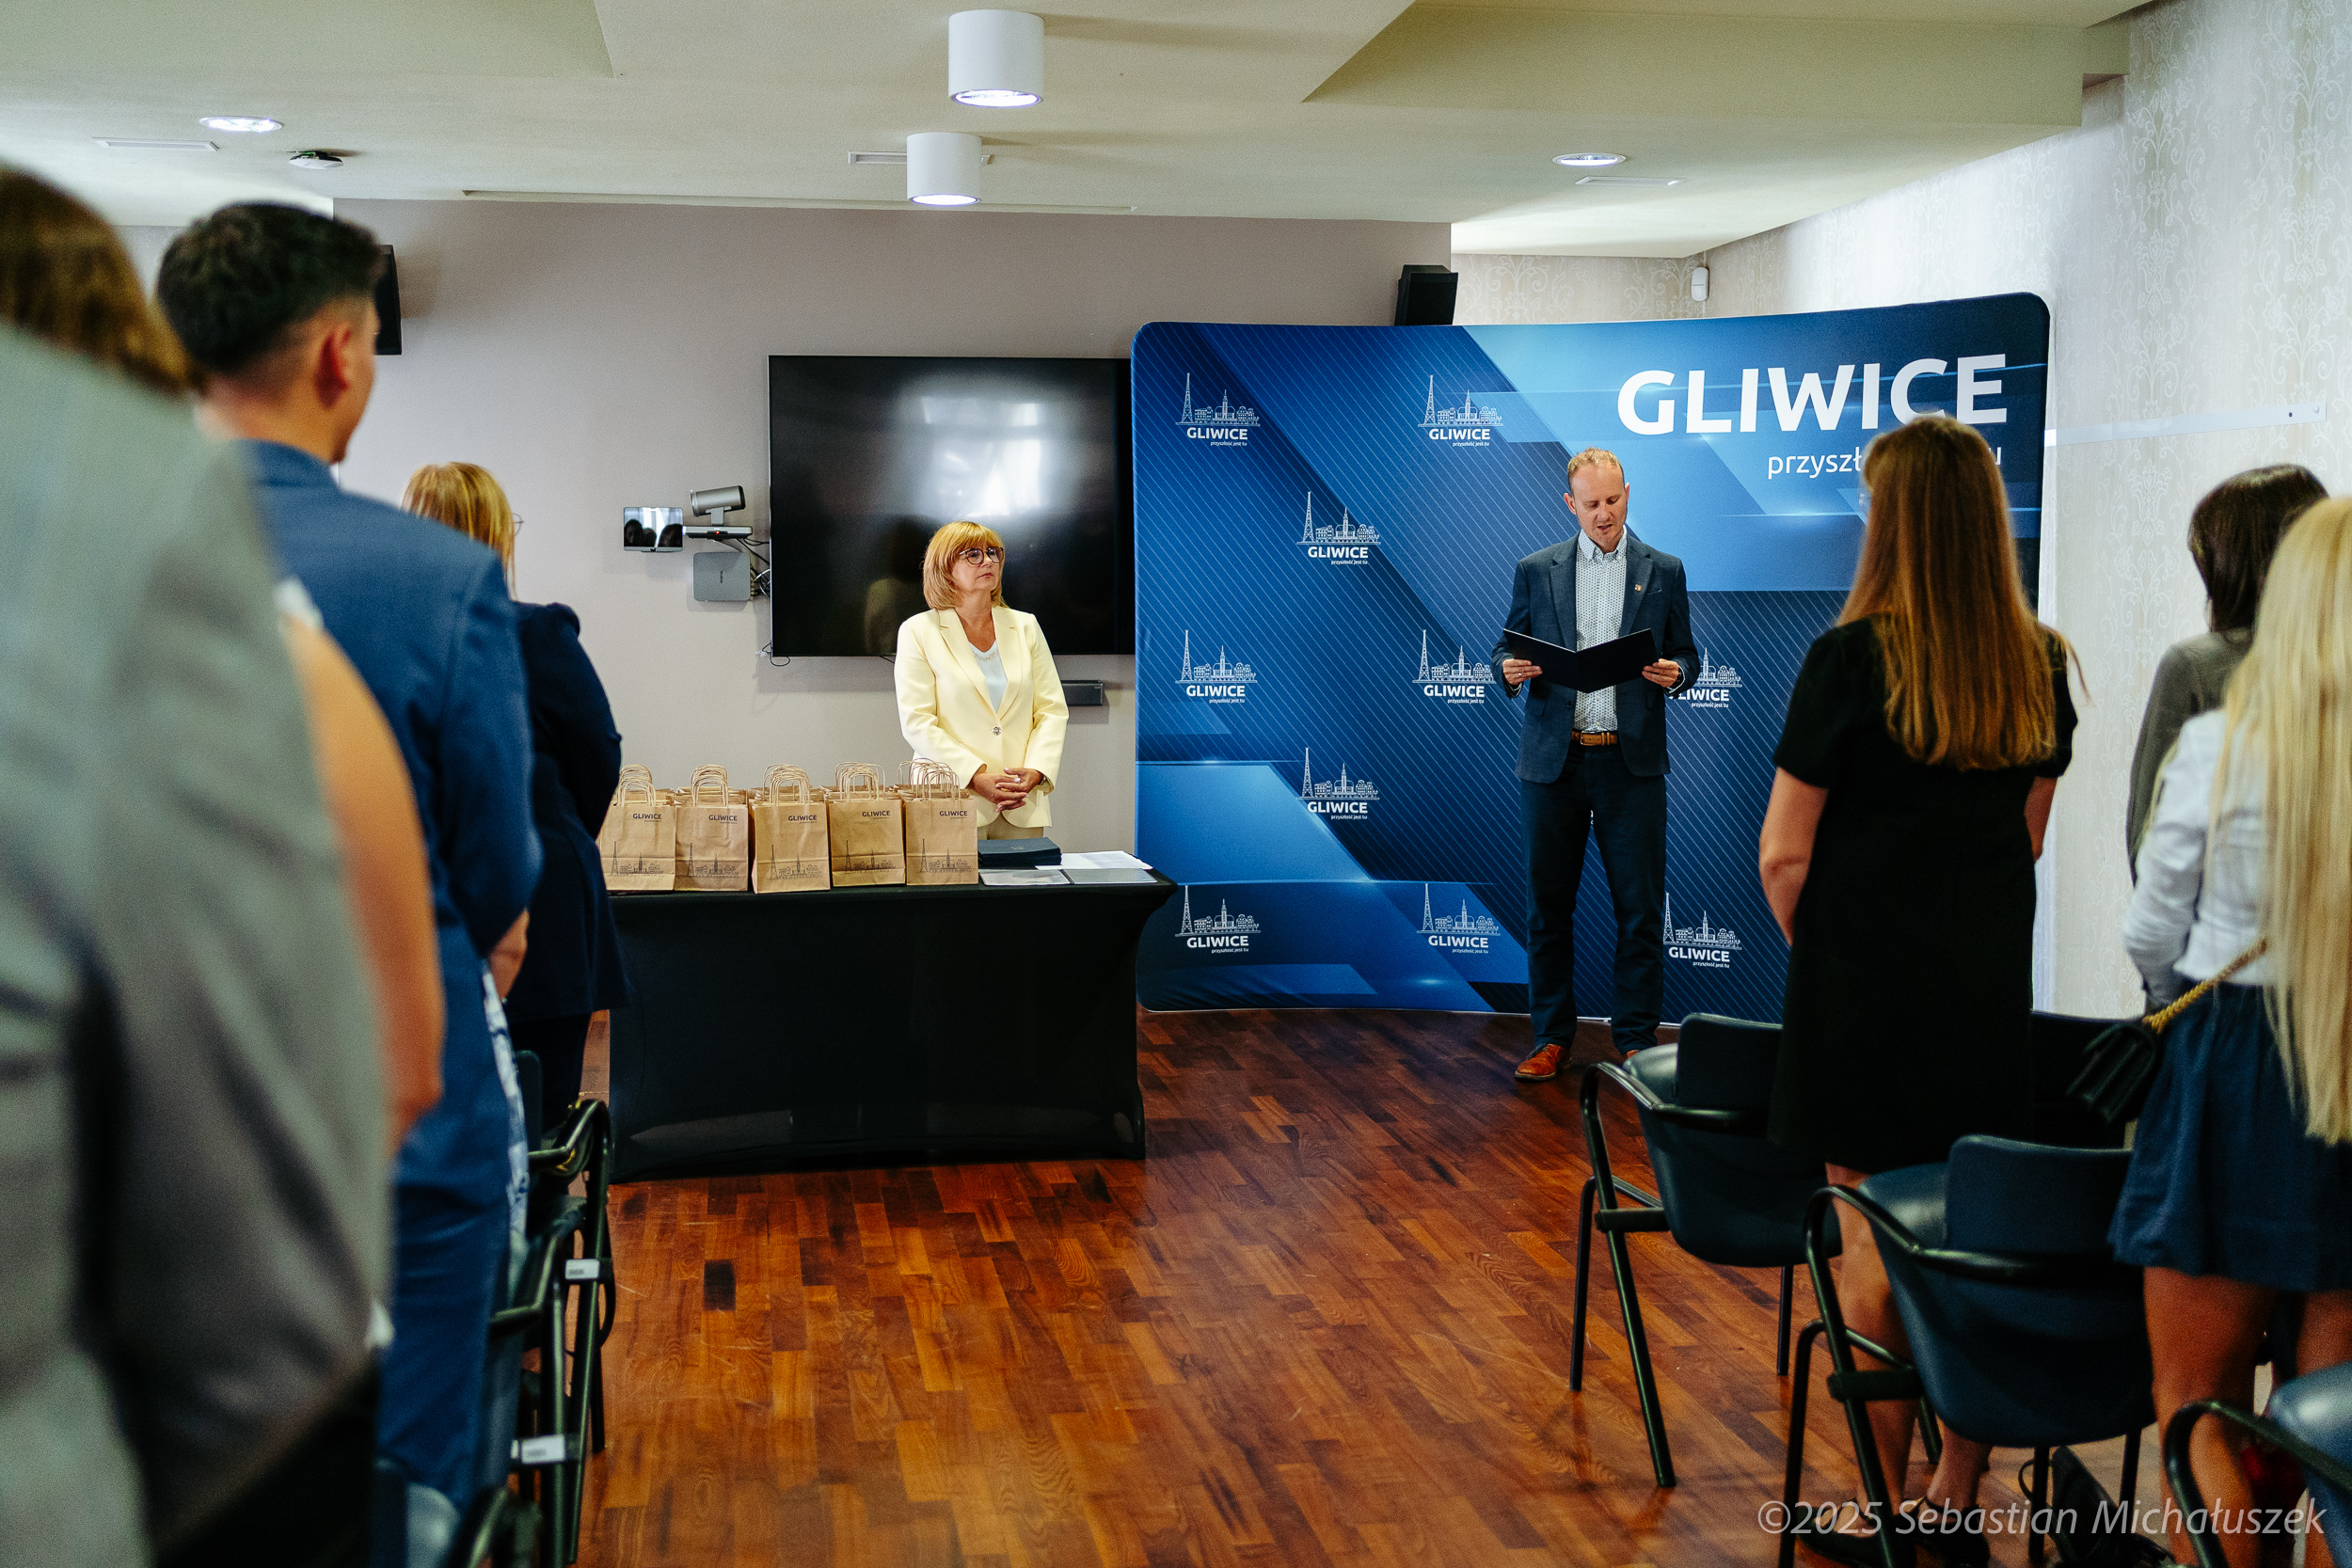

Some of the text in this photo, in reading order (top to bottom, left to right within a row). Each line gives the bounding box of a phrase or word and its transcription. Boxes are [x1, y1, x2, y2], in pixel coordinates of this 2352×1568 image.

[1617, 354, 2007, 435] GLIWICE
[1187, 427, 1248, 439] GLIWICE
[1429, 429, 1490, 440] GLIWICE
[1768, 447, 1863, 480] przyszł
[1308, 546, 1368, 558] GLIWICE
[1186, 685, 1246, 696] GLIWICE
[1424, 685, 1485, 697] GLIWICE
[1669, 689, 1729, 701] LIWICE
[1308, 801, 1368, 813] GLIWICE
[1187, 936, 1248, 948] GLIWICE
[1428, 935, 1488, 948] GLIWICE
[1669, 947, 1730, 962] GLIWICE
